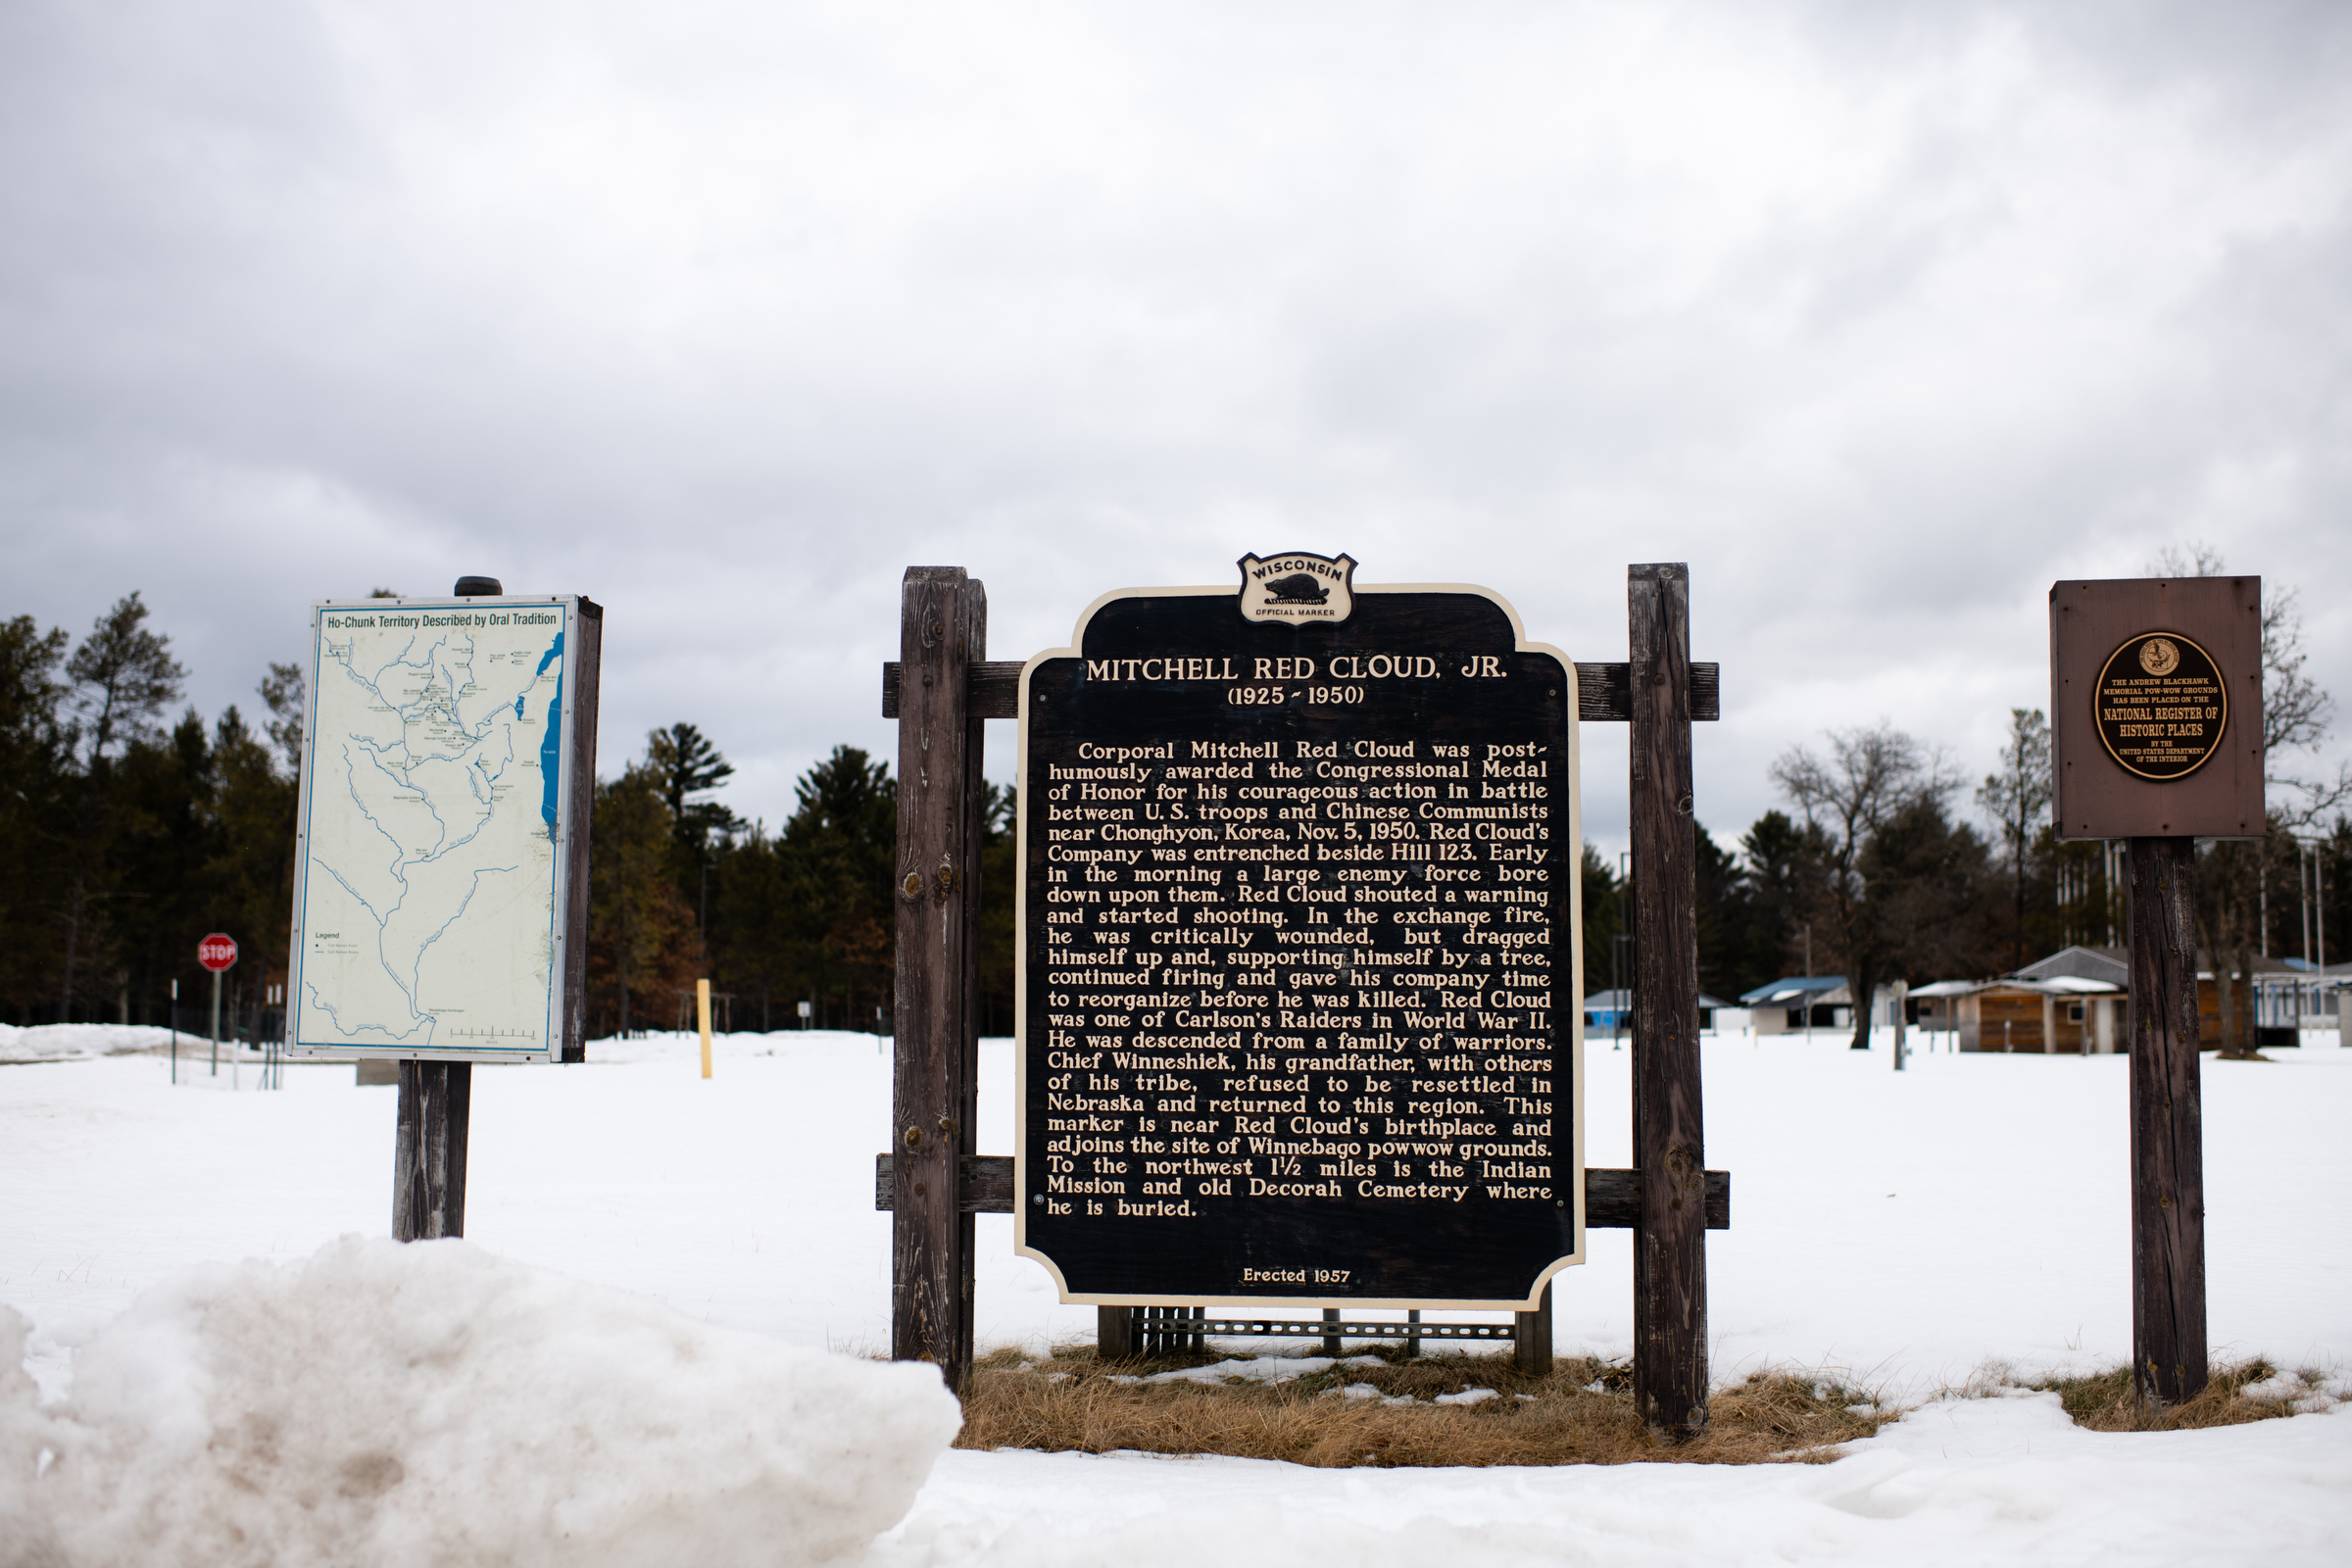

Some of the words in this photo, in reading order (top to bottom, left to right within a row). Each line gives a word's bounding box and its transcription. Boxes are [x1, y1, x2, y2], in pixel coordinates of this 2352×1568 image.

[1251, 559, 1343, 582] WISCONSIN
[328, 616, 375, 628] Ho-Chunk
[379, 615, 419, 629] Territory
[423, 614, 471, 626] Described
[474, 615, 487, 628] by
[489, 613, 509, 625] Oral
[513, 613, 557, 625] Tradition
[1086, 658, 1238, 681] MITCHELL
[1254, 658, 1315, 680] RED
[1329, 656, 1441, 680] CLOUD,
[1461, 656, 1507, 678] JR.
[1228, 687, 1285, 705] (1925
[1308, 686, 1364, 705] 1950)
[2104, 709, 2152, 720] NATIONAL
[2155, 708, 2202, 719] REGISTER
[2206, 707, 2218, 719] OF
[2120, 724, 2165, 737] HISTORIC
[2168, 724, 2203, 736] PLACES
[1079, 743, 1173, 762] Corporal
[1192, 742, 1278, 758] Mitchell
[1298, 742, 1337, 758] Red
[1355, 741, 1413, 757] Cloud
[1433, 746, 1469, 757] was
[1050, 763, 1152, 782] humously
[1166, 762, 1252, 778] awarded
[1269, 762, 1302, 778] the
[1317, 761, 1468, 782] Congressional
[1483, 760, 1546, 777] Medal
[1049, 805, 1134, 820] between
[1146, 804, 1163, 819] U.
[1171, 804, 1189, 819] S.
[1199, 805, 1267, 823] troops
[1279, 804, 1316, 818] and
[1327, 803, 1409, 818] Chinese
[1420, 803, 1547, 818] Communists
[1049, 829, 1095, 840] near
[1102, 824, 1218, 845] Chonghyon,
[1225, 823, 1290, 841] Korea,
[1298, 823, 1338, 839] Nov.
[1345, 822, 1362, 841] 5,
[1370, 822, 1419, 839] 1950.
[1430, 823, 1470, 839] Red
[1476, 823, 1547, 839] Cloud's
[1049, 846, 1142, 864] Company
[1152, 850, 1186, 860] was
[1195, 845, 1309, 860] entrenched
[1317, 844, 1384, 860] beside
[1392, 844, 1430, 859] Hill
[1440, 844, 1477, 859] 123.
[1490, 844, 1548, 863] Early
[1048, 908, 1083, 923] and
[1100, 907, 1178, 923] started
[1195, 907, 1288, 928] shooting.
[1308, 907, 1328, 923] In
[1345, 907, 1378, 923] the
[1394, 907, 1491, 928] exchange
[1504, 906, 1548, 924] fire,
[1049, 928, 1072, 943] he
[1094, 932, 1129, 944] was
[1152, 927, 1252, 948] critically
[1276, 927, 1374, 945] wounded,
[1404, 928, 1441, 944] but
[1463, 928, 1549, 949] dragged
[202, 945, 235, 960] STOP
[1049, 948, 1127, 964] himself
[1136, 954, 1162, 969] up
[1172, 949, 1215, 966] and,
[1228, 950, 1344, 969] supporting
[1354, 949, 1433, 964] himself
[1442, 949, 1470, 968] by
[1481, 954, 1491, 964] a
[1500, 950, 1550, 966] tree,
[1049, 969, 1149, 985] continued
[1162, 968, 1224, 989] firing
[1238, 969, 1275, 985] and
[1290, 973, 1336, 989] gave
[1350, 969, 1380, 985] his
[1394, 974, 1490, 990] company
[1502, 971, 1550, 986] time
[1049, 1052, 1102, 1068] Chief
[1112, 1053, 1235, 1071] Winneshiek,
[1247, 1054, 1275, 1069] his
[1286, 1054, 1414, 1073] grandfather,
[1428, 1054, 1473, 1071] with
[1485, 1054, 1551, 1071] others
[1049, 1094, 1144, 1110] Nebraska
[1158, 1096, 1195, 1111] and
[1210, 1096, 1305, 1112] returned
[1319, 1098, 1340, 1112] to
[1353, 1097, 1393, 1113] this
[1408, 1099, 1484, 1117] region.
[1504, 1097, 1551, 1114] This
[1049, 1115, 1123, 1131] marker
[1140, 1117, 1154, 1131] is
[1171, 1121, 1218, 1132] near
[1235, 1116, 1275, 1133] Red
[1291, 1117, 1368, 1134] Cloud's
[1386, 1118, 1495, 1139] birthplace
[1513, 1119, 1550, 1136] and
[1048, 1135, 1123, 1155] adjoins
[1131, 1137, 1164, 1152] the
[1172, 1138, 1209, 1153] site
[1217, 1137, 1240, 1153] of
[1249, 1137, 1360, 1159] Winnebago
[1368, 1143, 1453, 1159] powwow
[1460, 1140, 1551, 1160] grounds.
[1048, 1155, 1073, 1172] To
[1093, 1157, 1127, 1173] the
[1146, 1158, 1252, 1174] northwest
[1272, 1156, 1300, 1175] 1½
[1320, 1159, 1376, 1176] miles
[1395, 1160, 1410, 1176] is
[1429, 1160, 1463, 1177] the
[1483, 1160, 1550, 1178] Indian
[1048, 1175, 1125, 1193] Mission
[1143, 1178, 1181, 1194] and
[1200, 1179, 1231, 1195] old
[1250, 1178, 1342, 1196] Decorah
[1358, 1180, 1468, 1201] Cemetery
[1487, 1182, 1551, 1199] where
[1243, 1267, 1305, 1283] Erected
[1314, 1269, 1350, 1284] 1957
